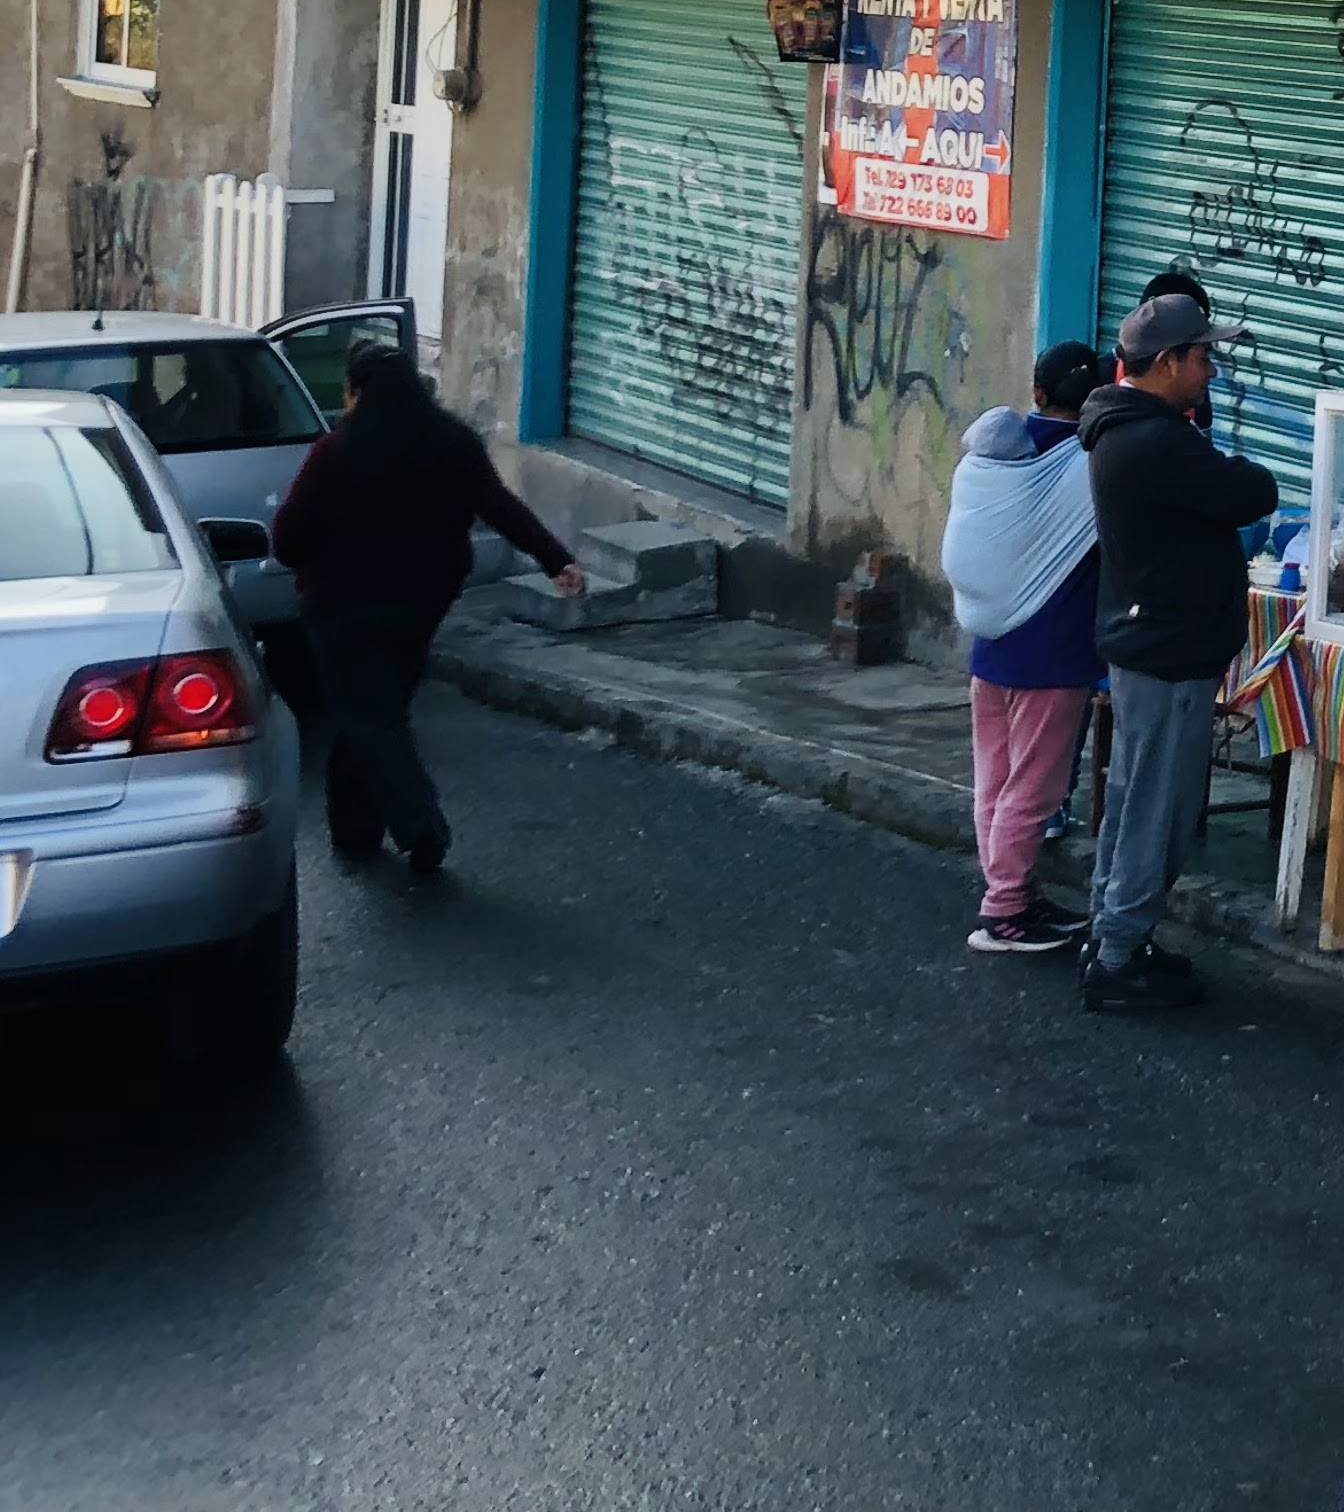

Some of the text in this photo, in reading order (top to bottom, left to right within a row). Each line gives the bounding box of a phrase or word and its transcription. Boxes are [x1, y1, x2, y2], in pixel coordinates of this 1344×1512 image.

[910, 26, 936, 56] DE
[862, 68, 986, 115] ANDAMIOS
[919, 126, 984, 170] AQUI
[911, 172, 933, 193] 173
[956, 178, 975, 199] 03
[956, 205, 978, 225] 00
